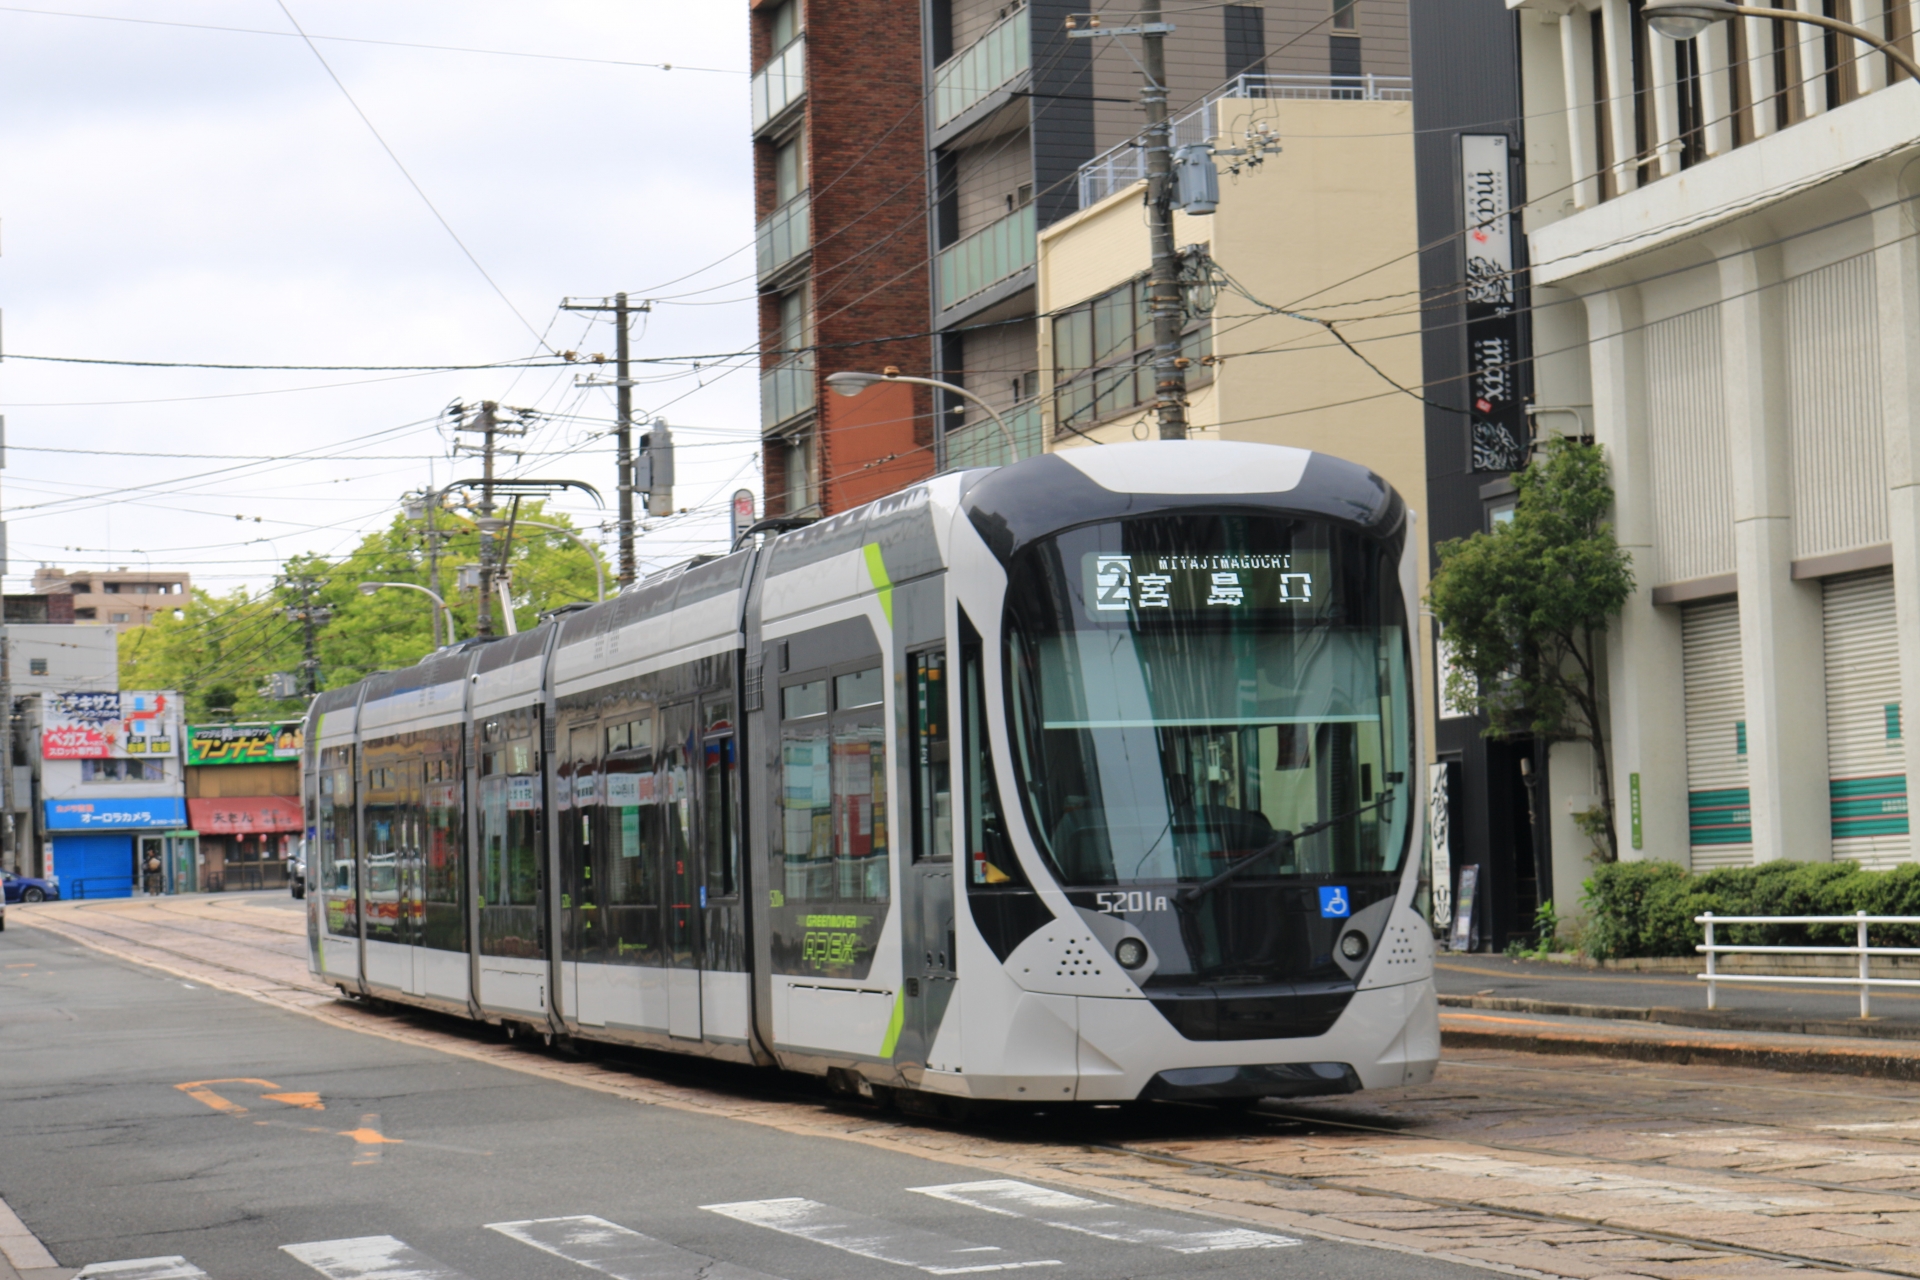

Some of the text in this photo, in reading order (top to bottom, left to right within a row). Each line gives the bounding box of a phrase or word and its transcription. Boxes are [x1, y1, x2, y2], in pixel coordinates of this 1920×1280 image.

[1476, 170, 1496, 232] max
[1482, 337, 1504, 402] max
[1158, 554, 1291, 570] MIYAJIMAGUCHI
[1137, 572, 1312, 607] 宮島口
[48, 732, 89, 746] ベガス
[81, 812, 152, 824] オーロラカメラ
[1096, 891, 1168, 913] 5201A
[802, 931, 857, 969] APEX
